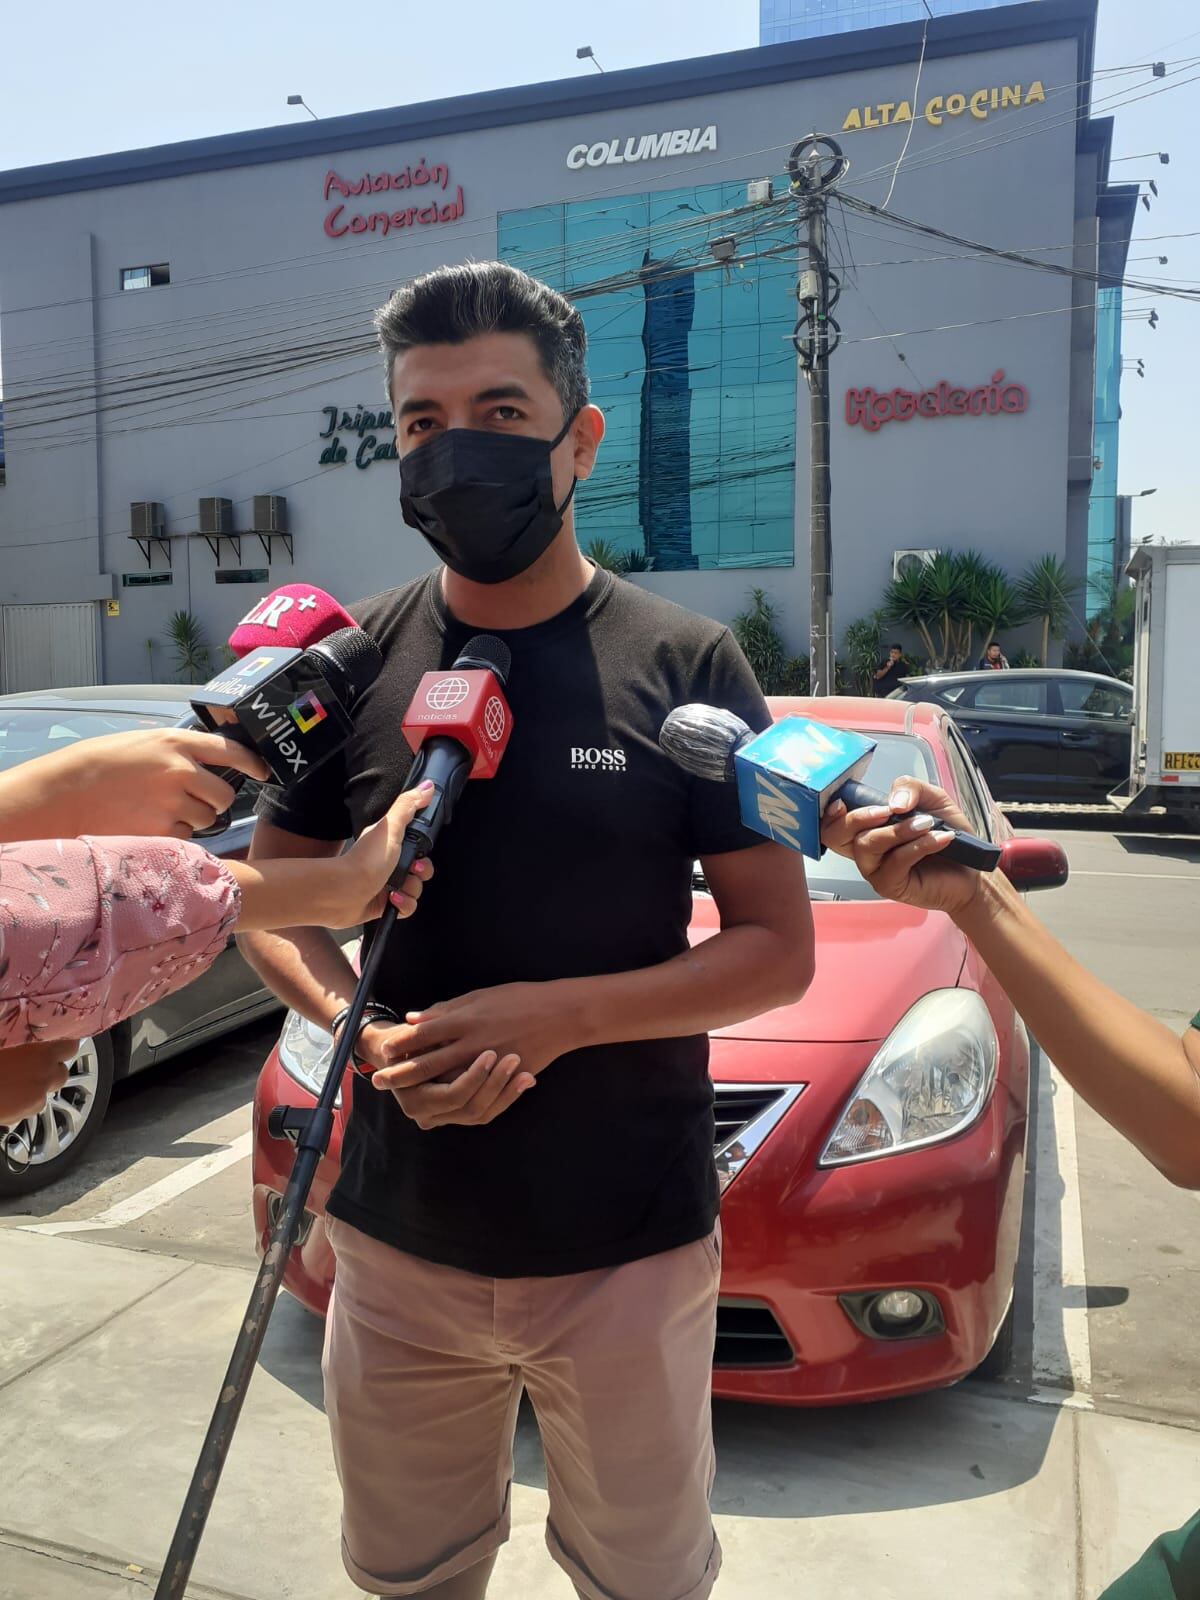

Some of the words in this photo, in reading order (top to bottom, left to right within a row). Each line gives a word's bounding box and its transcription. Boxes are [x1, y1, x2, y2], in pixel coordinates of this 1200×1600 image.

[842, 101, 913, 131] ALTA
[923, 80, 1046, 126] COCINA
[566, 125, 717, 170] COLUMBIA
[324, 157, 449, 200] Aviación
[324, 184, 465, 238] Comercial
[318, 437, 347, 465] de
[251, 692, 308, 774] willax
[571, 747, 626, 766] BOSS
